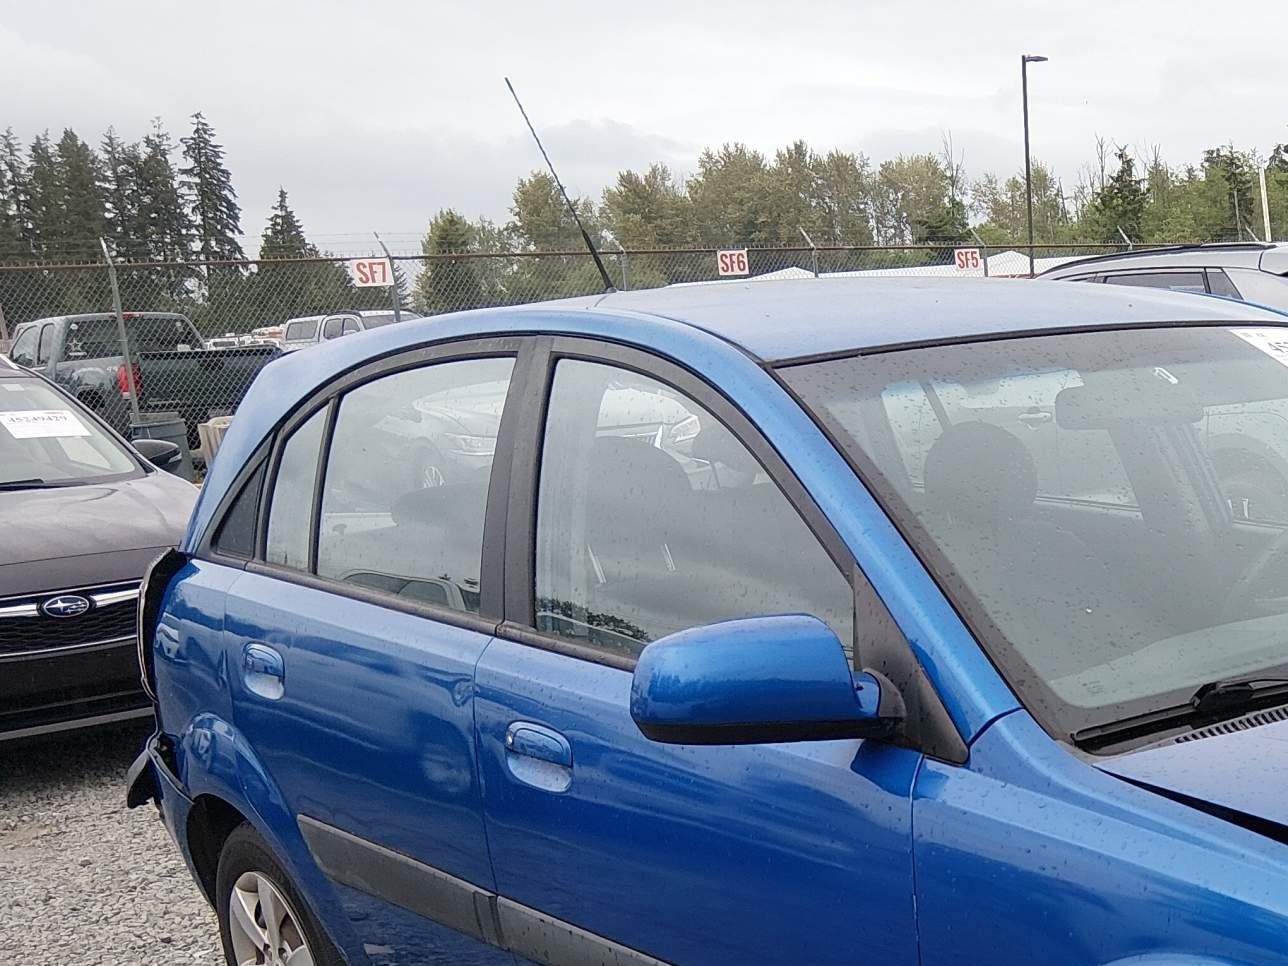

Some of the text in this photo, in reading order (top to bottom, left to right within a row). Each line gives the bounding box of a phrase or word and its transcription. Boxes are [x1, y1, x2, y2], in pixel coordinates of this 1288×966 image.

[719, 252, 746, 273] SF6
[957, 250, 979, 269] SF5
[356, 261, 386, 284] SF7
